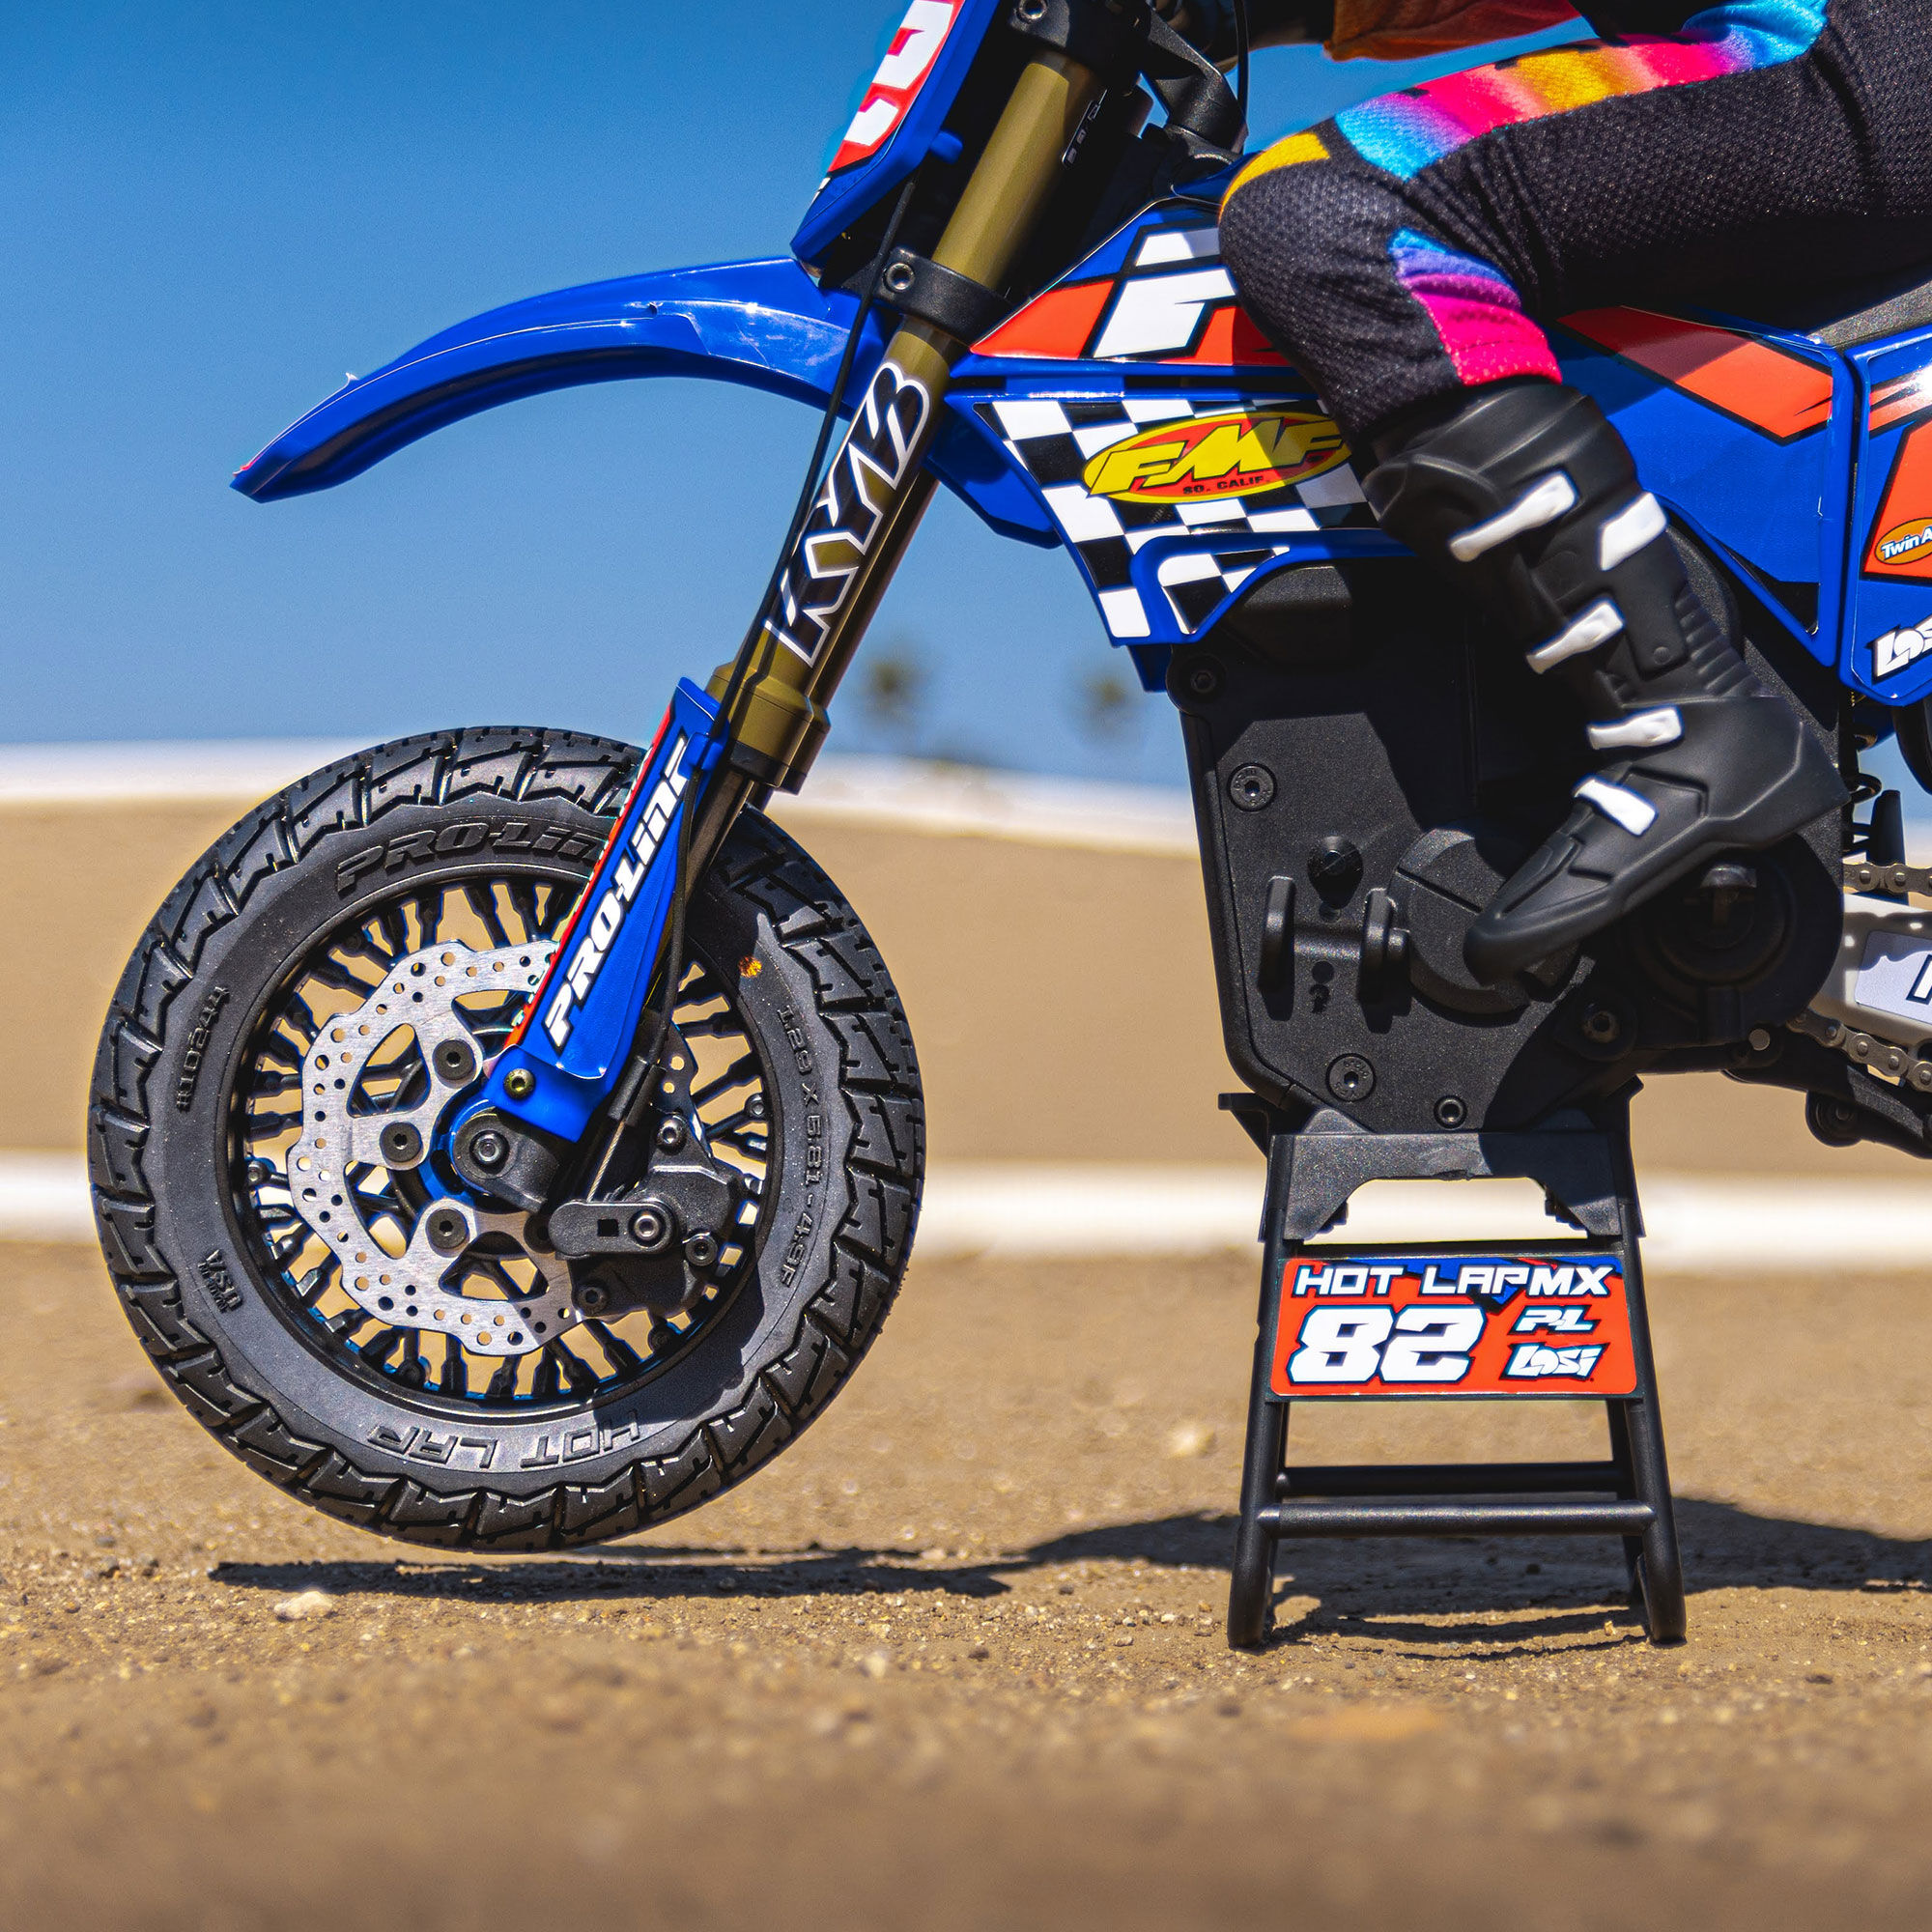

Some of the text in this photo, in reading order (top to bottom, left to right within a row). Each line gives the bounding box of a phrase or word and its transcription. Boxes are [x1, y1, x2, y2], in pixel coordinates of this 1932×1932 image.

[1088, 416, 1344, 496] FMF
[765, 361, 929, 668] KYB
[1880, 534, 1920, 559] Twin
[1293, 1266, 1405, 1296] HOT
[1287, 1305, 1487, 1384] 82
[367, 1408, 640, 1470] HOT LAP
